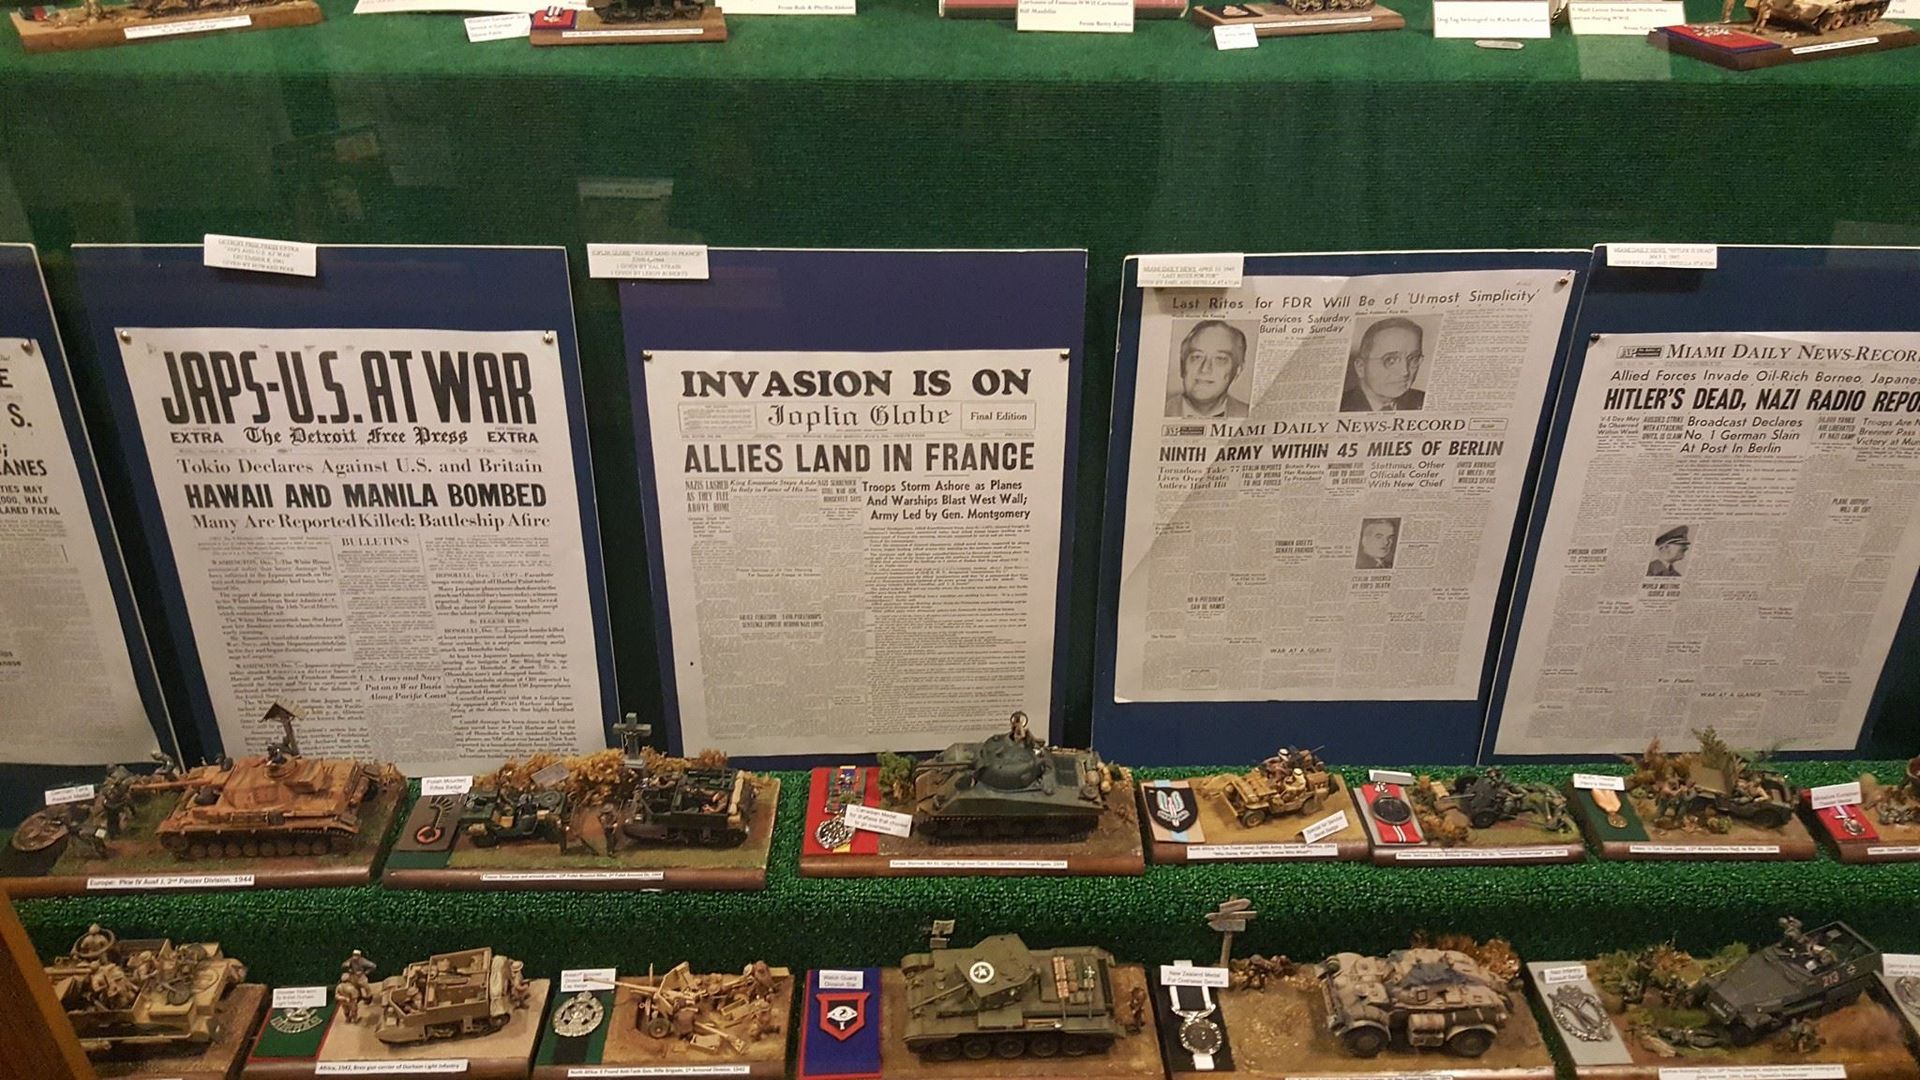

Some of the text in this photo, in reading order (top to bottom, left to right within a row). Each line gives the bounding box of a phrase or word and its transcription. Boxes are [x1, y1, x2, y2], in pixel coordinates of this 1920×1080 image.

[1172, 288, 1540, 309] Last Rites for FDR Will Be of 'Utmost Simplicity'
[1262, 314, 1302, 323] Services
[1260, 324, 1345, 334] Burial on Sunday
[1666, 344, 1920, 362] MIAMI DAILY NEWS-RECOR
[680, 368, 1032, 398] INVASION IS ON
[1610, 370, 1649, 382] Allied
[1656, 370, 1696, 382] Forces
[1704, 371, 1749, 382] Invade
[1756, 370, 1808, 382] Oil-Rich
[1815, 372, 1863, 384] Borneo,
[162, 350, 537, 425] JAPS-U.S. AT WAR
[1603, 388, 1920, 412] HITLER'S DEAD, NAZI RADIO REPO
[7, 403, 32, 428] S.
[768, 403, 952, 433] Joplin Globe
[970, 412, 1027, 421] Final Edition
[1687, 416, 1803, 428] Broadcast Declares
[1862, 417, 1911, 426] Troops Are
[1210, 418, 1466, 438] MIAMI DAILY NEWS-RECORD
[1710, 430, 1716, 440] 1
[1720, 430, 1767, 441] German
[1770, 429, 1800, 440] Slain
[1859, 428, 1915, 436] Brenner Pass
[170, 427, 539, 445] EXTRA The Detroit Free Press EXTRA
[1856, 438, 1889, 446] Victory
[1159, 440, 1504, 462] NINTH ARMY WITHIN 45 MILES OF BERLIN
[1680, 442, 1781, 454] At Post In Berlin
[684, 442, 1035, 473] ALLIES LAND IN FRANCE
[0, 460, 47, 476] ANES
[177, 458, 542, 477] Tokio Declares Against U.S. and Britain
[1418, 461, 1446, 469] Other
[1370, 470, 1439, 479] Officials Confer
[862, 481, 896, 493] Troops
[900, 480, 930, 492] Storm
[935, 480, 970, 491] Ashore
[975, 482, 985, 491] as
[990, 480, 1022, 490] Planes
[1368, 480, 1391, 488] With
[1419, 479, 1444, 487] Chief
[185, 483, 547, 509] HAWAII AND MANILA BOMBED
[866, 493, 1028, 508] And Warships Blast West Wall;
[32, 506, 60, 515] FATAL
[870, 508, 1031, 522] Army Led by Gen. Montgomery
[193, 513, 550, 533] Many Are Reported Killed: Battleship Afire
[342, 536, 409, 546] BULLETINS
